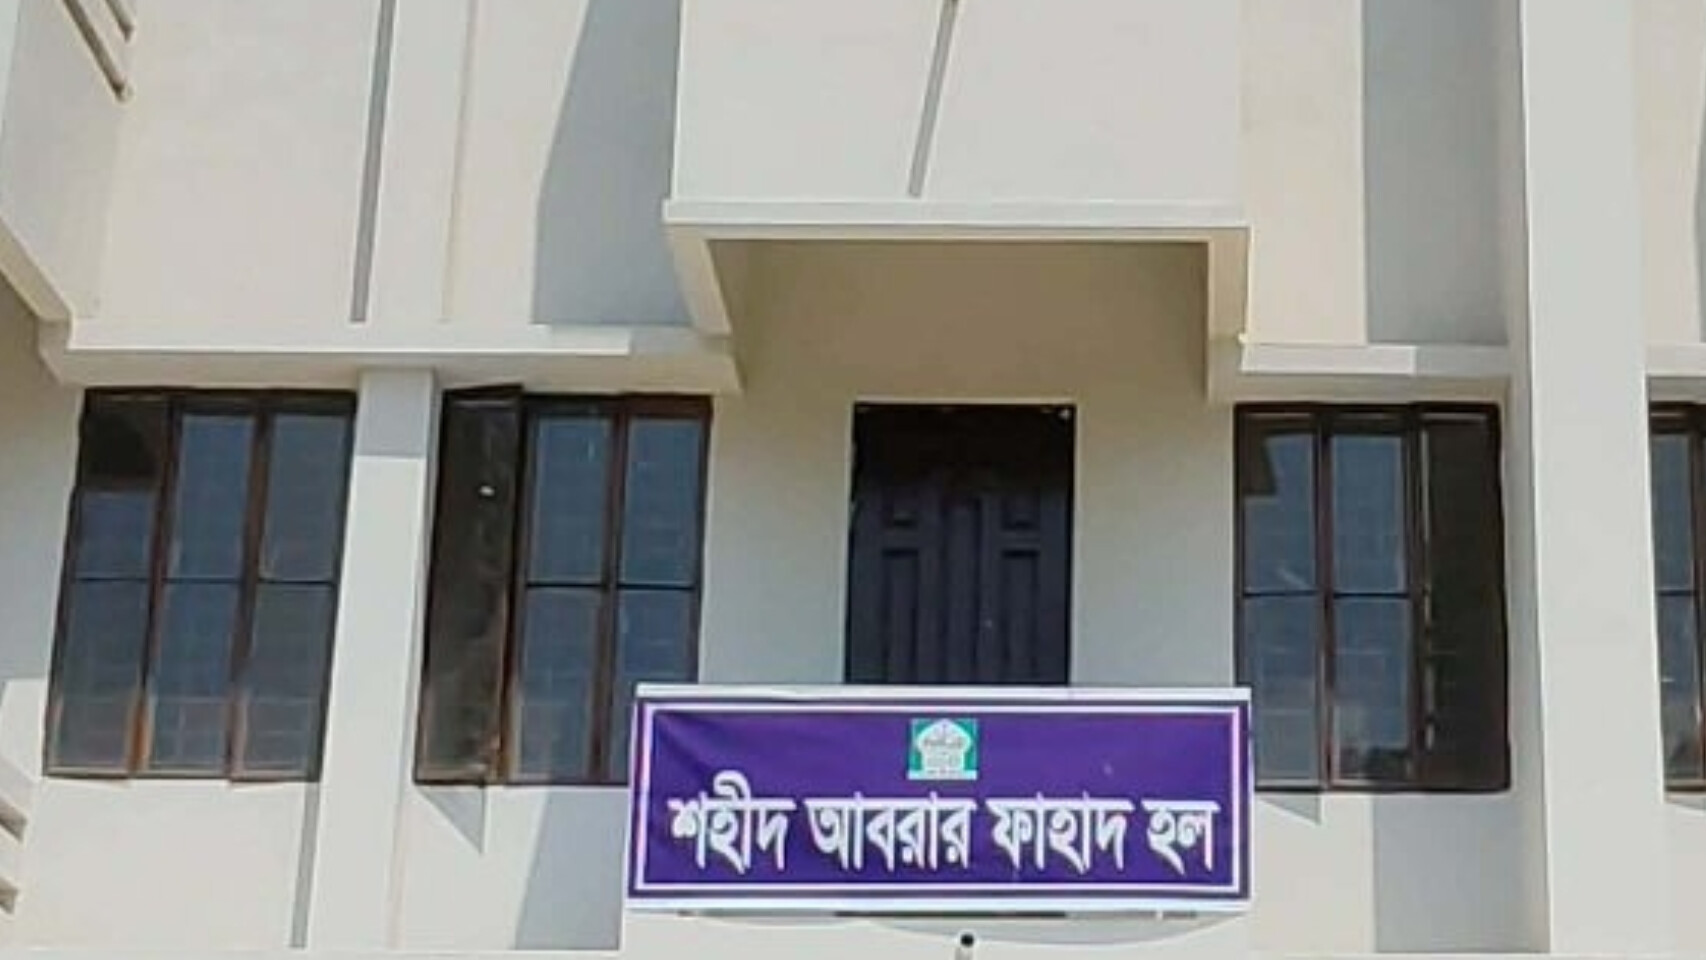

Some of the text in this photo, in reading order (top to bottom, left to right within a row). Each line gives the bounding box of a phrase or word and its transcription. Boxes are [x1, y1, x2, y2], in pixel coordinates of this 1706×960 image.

[668, 770, 1220, 875] শহীদ আবরার ফাহাদ হল
